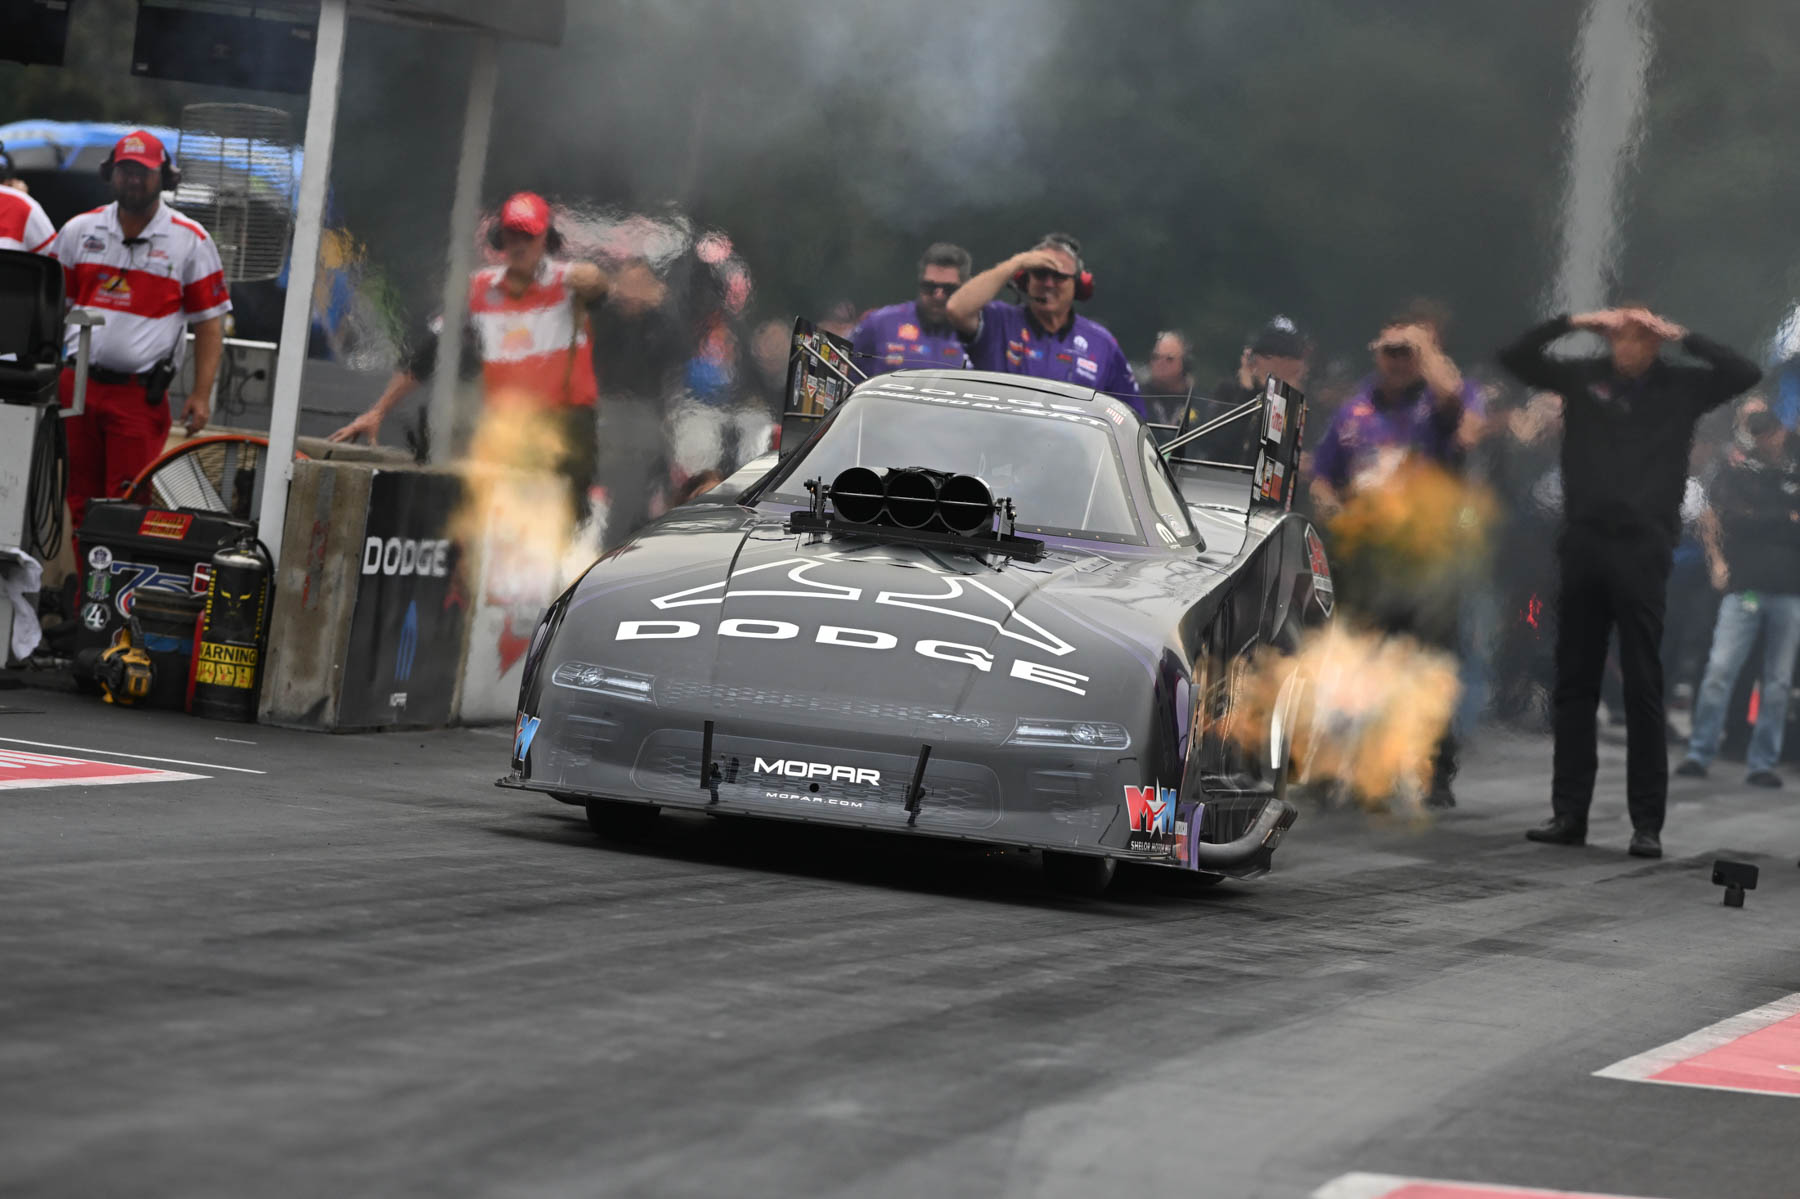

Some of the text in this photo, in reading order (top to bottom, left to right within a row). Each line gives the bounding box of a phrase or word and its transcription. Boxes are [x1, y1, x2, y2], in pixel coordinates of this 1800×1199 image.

[880, 383, 1086, 413] DODGE
[362, 536, 450, 577] DODGE
[201, 643, 257, 664] ARNING
[614, 618, 1091, 696] DODGE
[753, 756, 880, 786] MOPAR
[766, 791, 863, 808] MOPAR.COM
